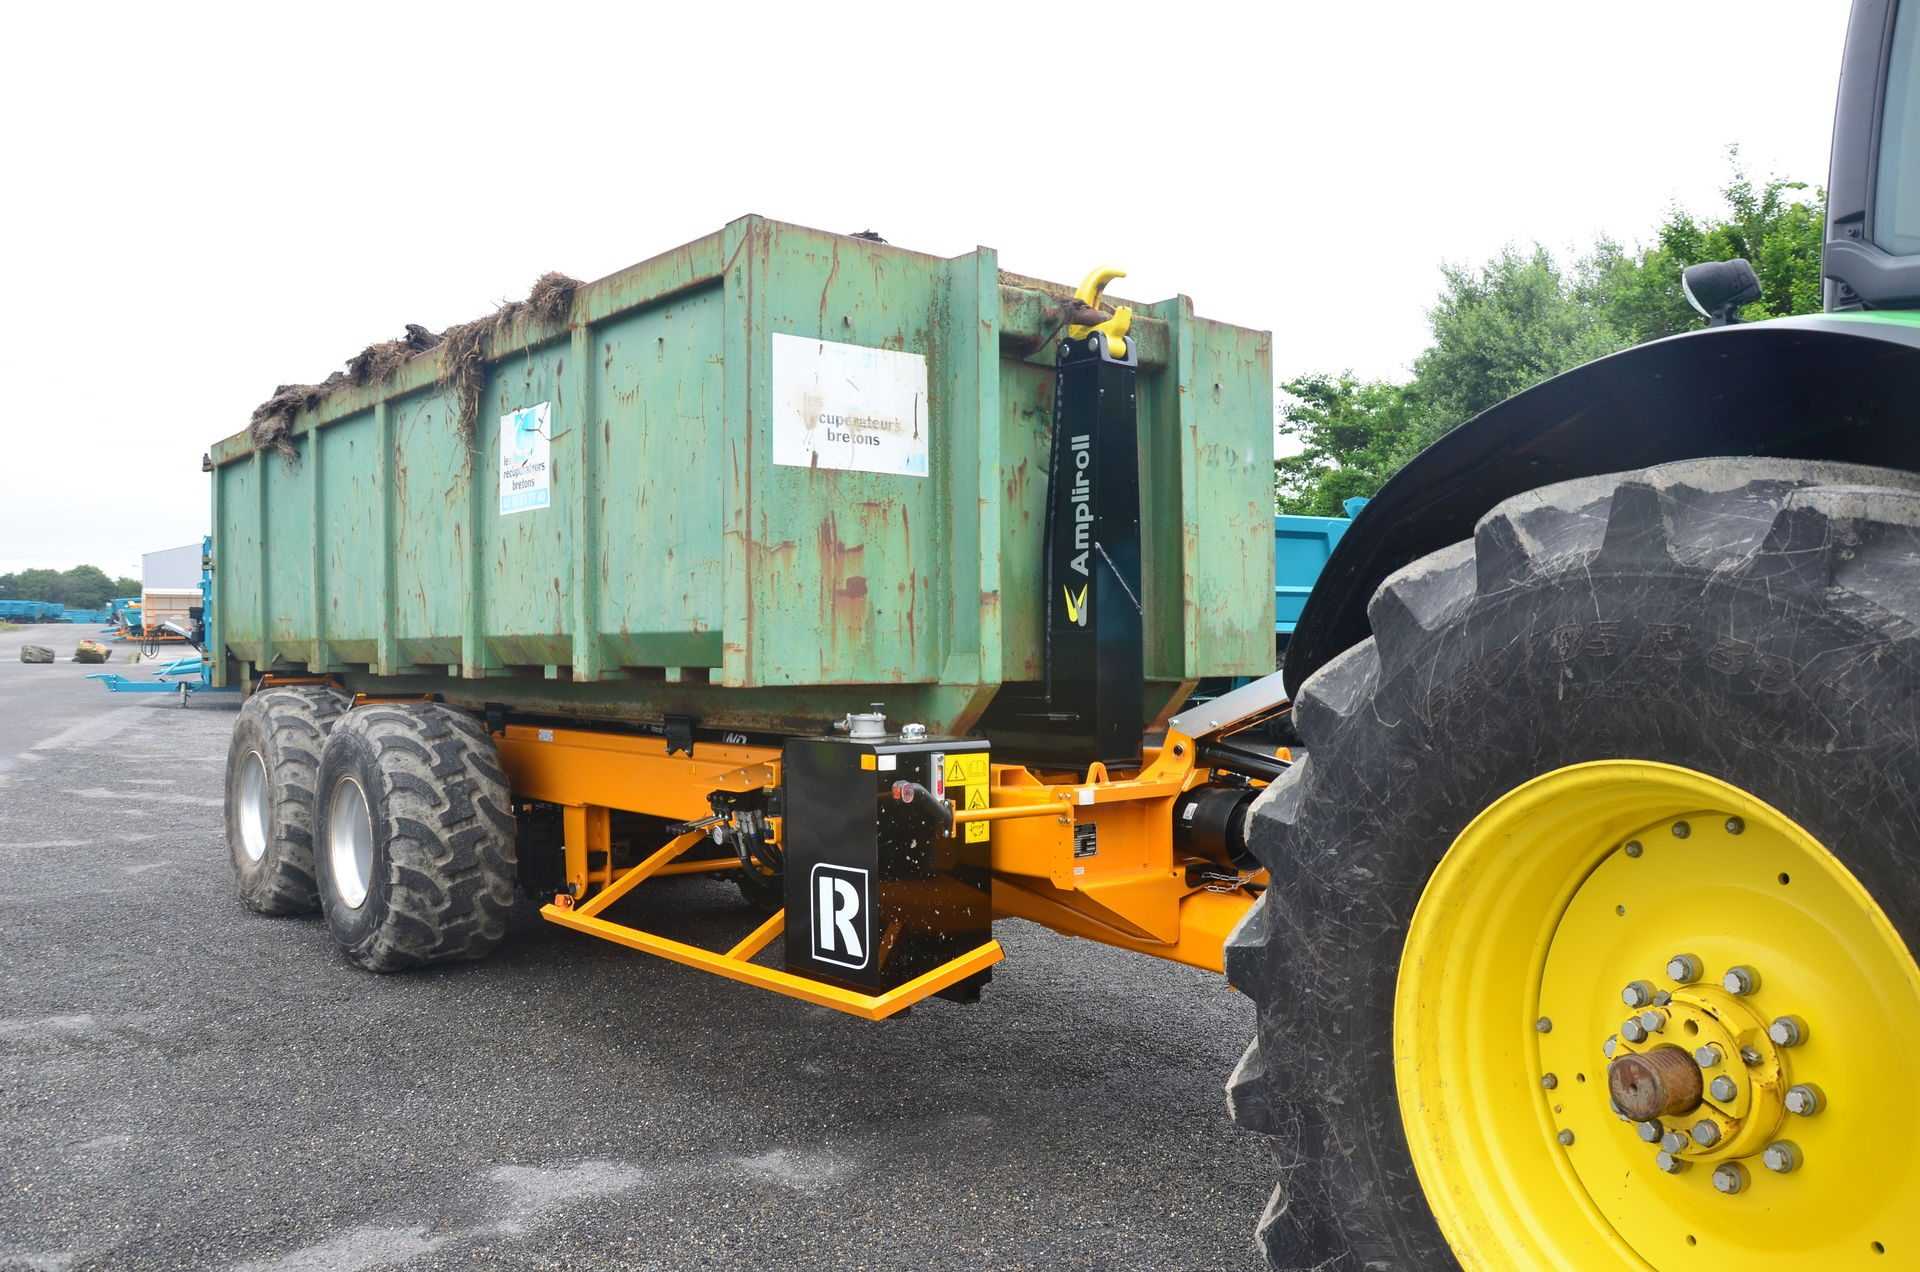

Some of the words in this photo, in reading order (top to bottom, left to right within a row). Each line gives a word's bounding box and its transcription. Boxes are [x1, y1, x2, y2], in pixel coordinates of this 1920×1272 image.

[826, 427, 881, 446] bretons
[1070, 434, 1095, 577] Ampliroll
[818, 875, 864, 958] R
